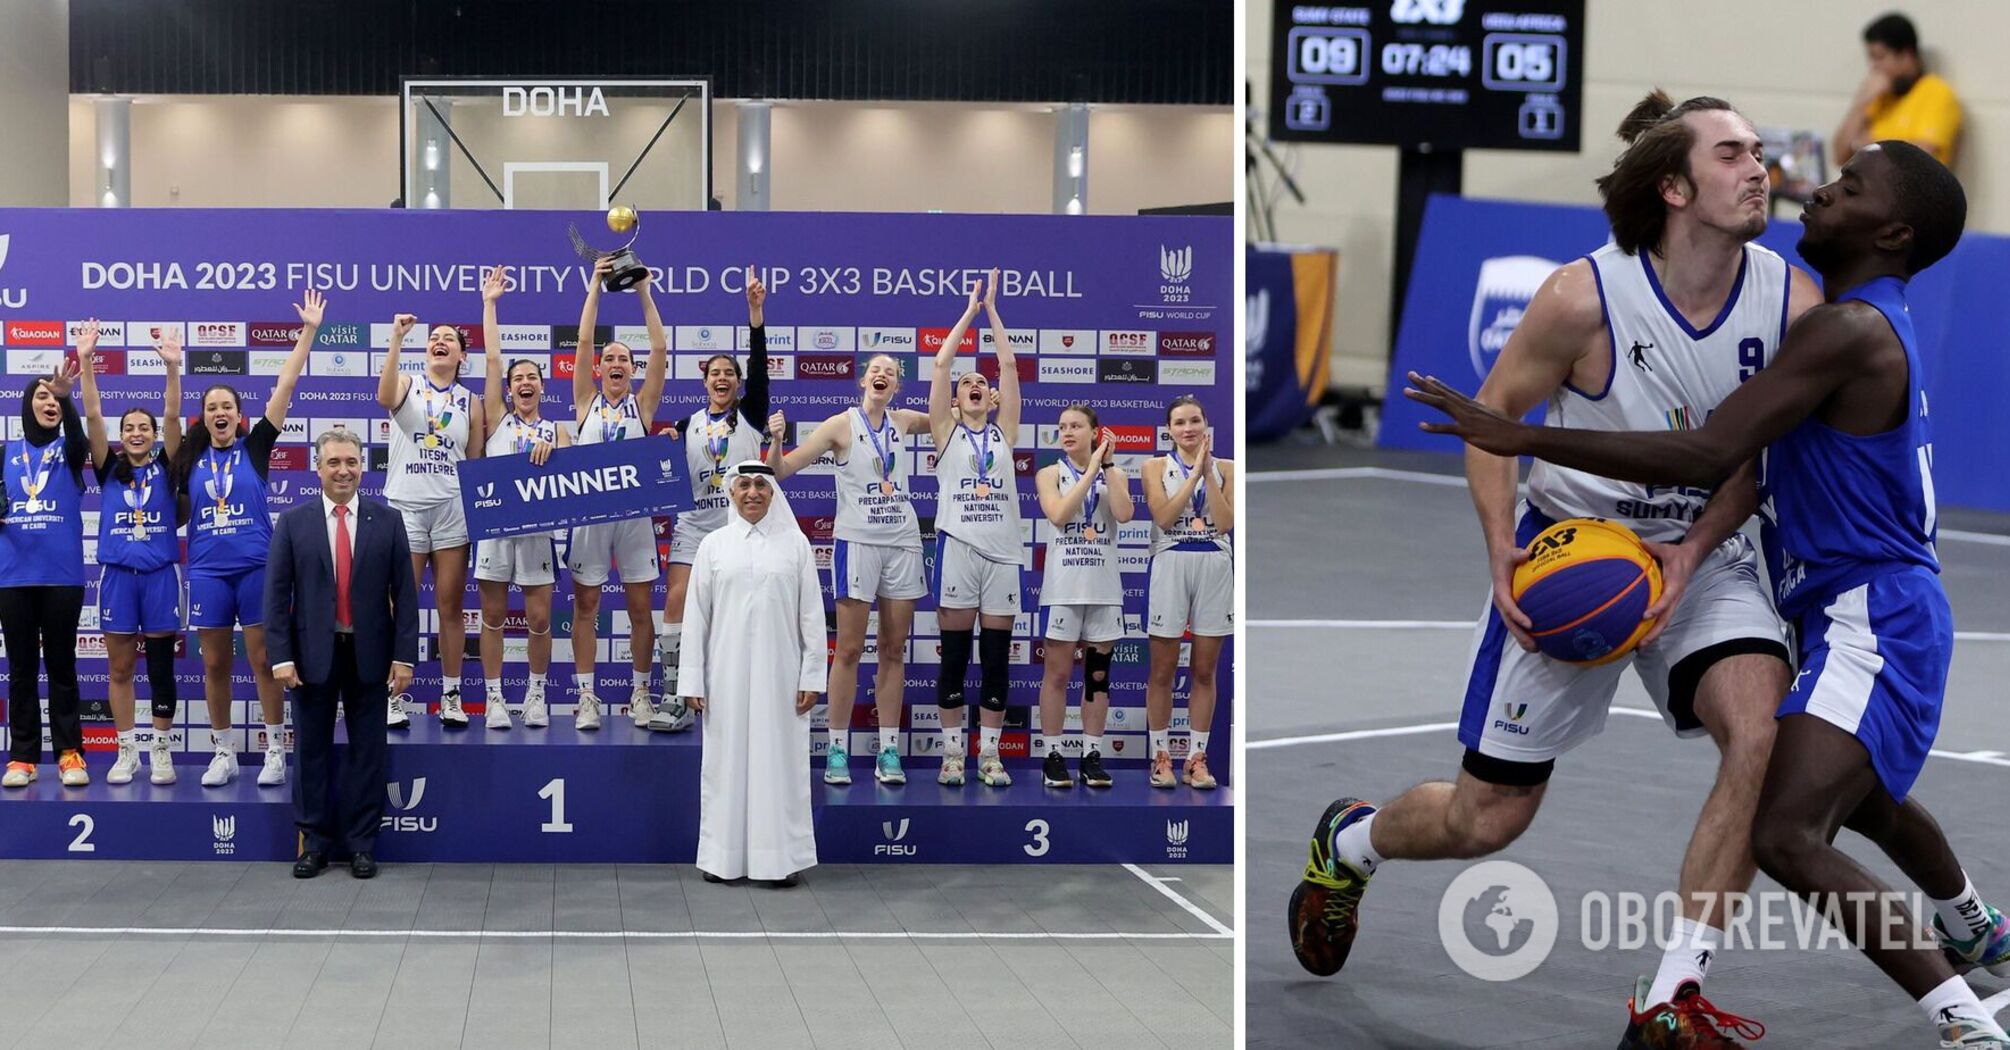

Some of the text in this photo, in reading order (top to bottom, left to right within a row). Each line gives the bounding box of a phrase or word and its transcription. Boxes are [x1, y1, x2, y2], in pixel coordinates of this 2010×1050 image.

[1301, 36, 1358, 75] 09
[1382, 42, 1471, 77] 07:24
[1497, 42, 1553, 81] 05
[503, 87, 609, 116] DOHA
[82, 262, 188, 290] DOHA
[195, 262, 277, 290] 2023
[287, 263, 359, 291] FISU
[579, 266, 710, 293] WRLD
[799, 268, 861, 294] 3X3
[873, 268, 1083, 298] BASKETBALL
[1160, 285, 1191, 294] DOHA
[1163, 294, 1189, 302] 2023
[1139, 311, 1165, 319] FISU
[1167, 311, 1194, 319] WORLD
[19, 329, 60, 340] QIAODAN
[330, 325, 357, 334] visit
[252, 329, 288, 341] QATAR
[319, 334, 358, 345] QATAR
[501, 333, 549, 341] EASHORE
[882, 336, 912, 344] FISU
[982, 334, 1033, 344] BNAN
[1161, 338, 1197, 350] QATAR
[130, 358, 183, 367] SEASHOE
[1739, 337, 1765, 384] 9
[800, 361, 835, 373] QATAR
[1042, 366, 1094, 375] SEASHORE
[72, 391, 125, 399] UNRSITY
[124, 391, 162, 399] WORLD
[183, 391, 201, 400] 3X3
[299, 392, 374, 401] DOHA 2023 FISU
[661, 396, 677, 404] ISU
[770, 395, 789, 404] CUP
[790, 396, 808, 404] 3X3
[906, 397, 929, 405] DOH
[1035, 399, 1069, 408] WORLD
[1091, 400, 1109, 408] 3X3
[1109, 400, 1166, 409] BASKETBALL
[536, 426, 554, 443] 13
[990, 429, 1001, 443] 3
[1115, 434, 1151, 444] IAODAN
[413, 432, 455, 450] FSU
[406, 462, 456, 476] MONTERRE
[514, 465, 642, 503] WINNER
[299, 487, 323, 496] DOH
[789, 491, 807, 500] 3X3
[267, 496, 293, 504] FISU
[475, 498, 502, 509] FISU
[963, 503, 1001, 512] NATIONAL
[1615, 498, 1692, 523] SUMY
[867, 514, 907, 524] UNIVERSITY
[961, 514, 1004, 523] UNIVERSITY
[1118, 525, 1149, 541] print
[1065, 547, 1103, 556] NATIONAL
[1062, 558, 1106, 567] UNIVERSITY
[601, 585, 626, 593] DOH
[504, 616, 528, 626] ATAR
[1113, 643, 1139, 653] visit
[1111, 652, 1139, 662] ATAR
[183, 675, 201, 683] 3X3
[464, 678, 484, 687] CUP
[600, 678, 628, 687] DOHA
[1109, 681, 1148, 691] ASKETBA
[1494, 719, 1530, 736] FISU
[537, 778, 573, 833] 1
[380, 816, 438, 832] FISU
[68, 813, 95, 852] 2
[1023, 818, 1050, 858] 3
[874, 844, 917, 856] FISU
